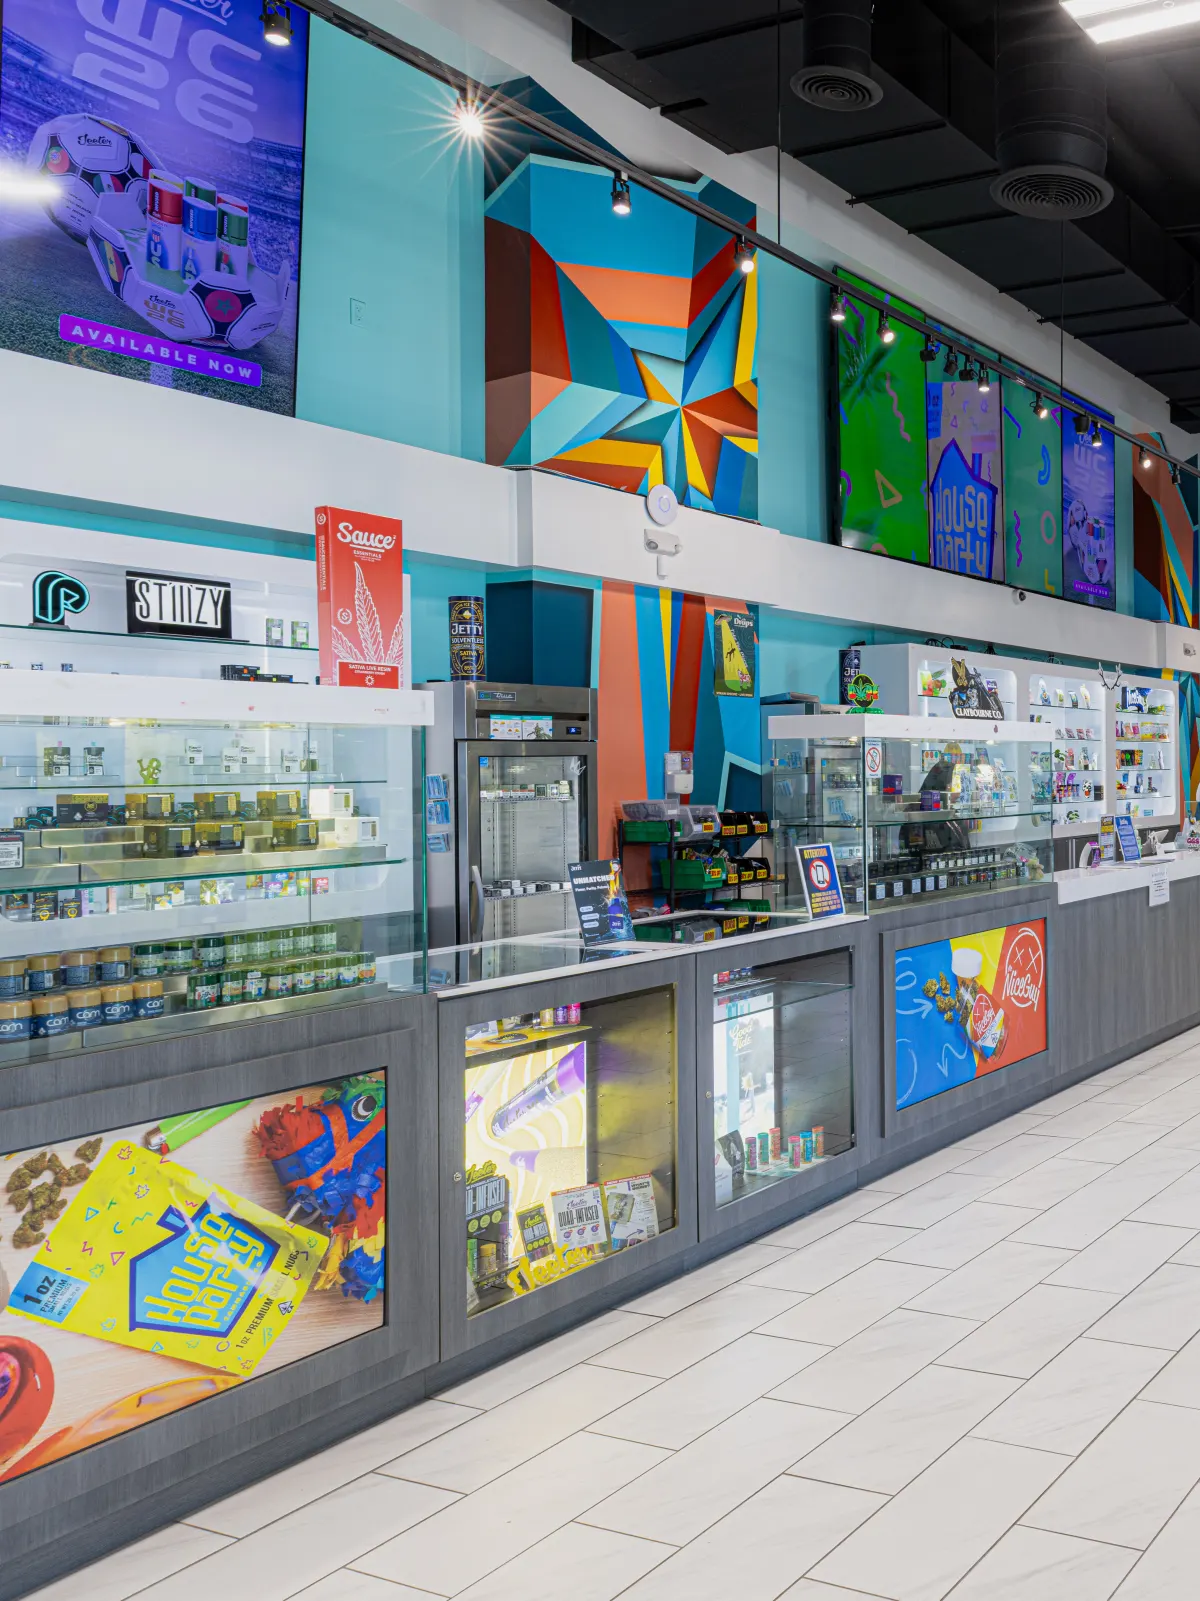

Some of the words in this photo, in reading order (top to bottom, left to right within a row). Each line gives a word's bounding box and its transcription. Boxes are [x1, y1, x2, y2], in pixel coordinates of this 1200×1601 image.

[72, 30, 258, 144] 26
[77, 133, 113, 147] Jeeter
[71, 325, 197, 366] AVAILABLE
[208, 358, 252, 379] NOW
[936, 477, 988, 538] House
[336, 522, 396, 550] Sauce
[353, 550, 382, 559] ESSENTIALS
[936, 531, 988, 578] party
[1075, 583, 1098, 594] AVAILABLE
[136, 579, 224, 628] STIIIZY
[451, 622, 483, 636] JETTY
[734, 617, 754, 628] Drops
[844, 667, 860, 676] JET
[955, 706, 992, 719] CLAYBOURNE
[573, 874, 615, 885] UNMATCHED
[1002, 967, 1040, 1012] NiceGuy
[76, 1010, 100, 1020] cam
[105, 1004, 130, 1014] cam
[558, 1204, 600, 1228] QUAD-INFUSED
[144, 1213, 236, 1324] House
[182, 1229, 266, 1329] party
[507, 1242, 592, 1296] Jeeter
[24, 1293, 42, 1305] 1
[40, 1279, 68, 1312] PREMIUM
[246, 1297, 274, 1334] PREMIUM
